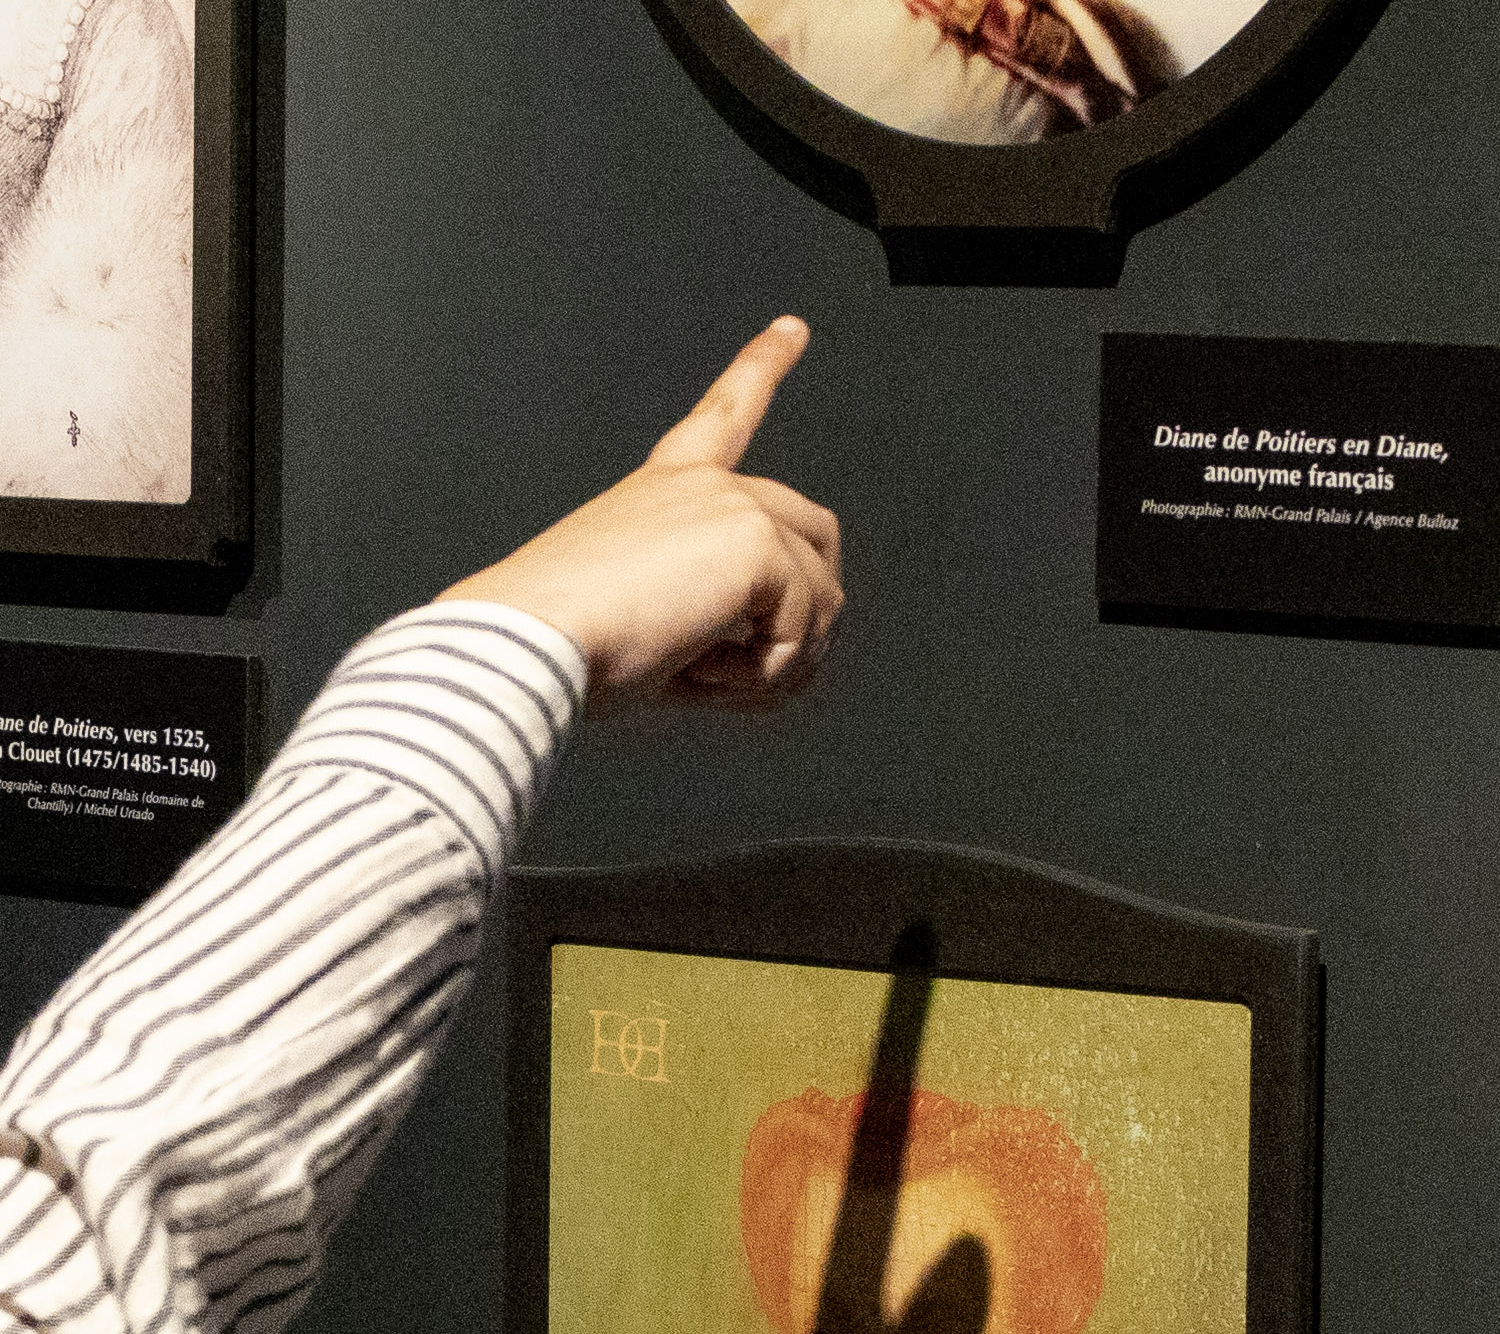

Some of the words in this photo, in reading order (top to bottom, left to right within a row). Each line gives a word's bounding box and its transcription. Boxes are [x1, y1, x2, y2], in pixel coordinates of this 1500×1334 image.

[1154, 425, 1217, 449] Diane
[1222, 427, 1250, 451] de
[1255, 429, 1337, 455] Poitiers
[1342, 439, 1370, 456] en
[1376, 434, 1449, 464] Diane,
[1204, 465, 1302, 491] anonyme
[1308, 463, 1394, 494] français
[1234, 504, 1313, 522] RMN-Grand
[1316, 508, 1351, 523] Palais
[1364, 512, 1414, 529] Agence
[1417, 514, 1459, 530] Bulloz
[28, 715, 48, 734] de
[53, 717, 118, 744] Poitiers,
[124, 728, 157, 744] vers
[163, 728, 209, 752] 1525,
[8, 741, 61, 764] Clouet
[66, 748, 216, 781] (1475/1485-1540)
[111, 788, 139, 801] Palais
[191, 796, 204, 807] de
